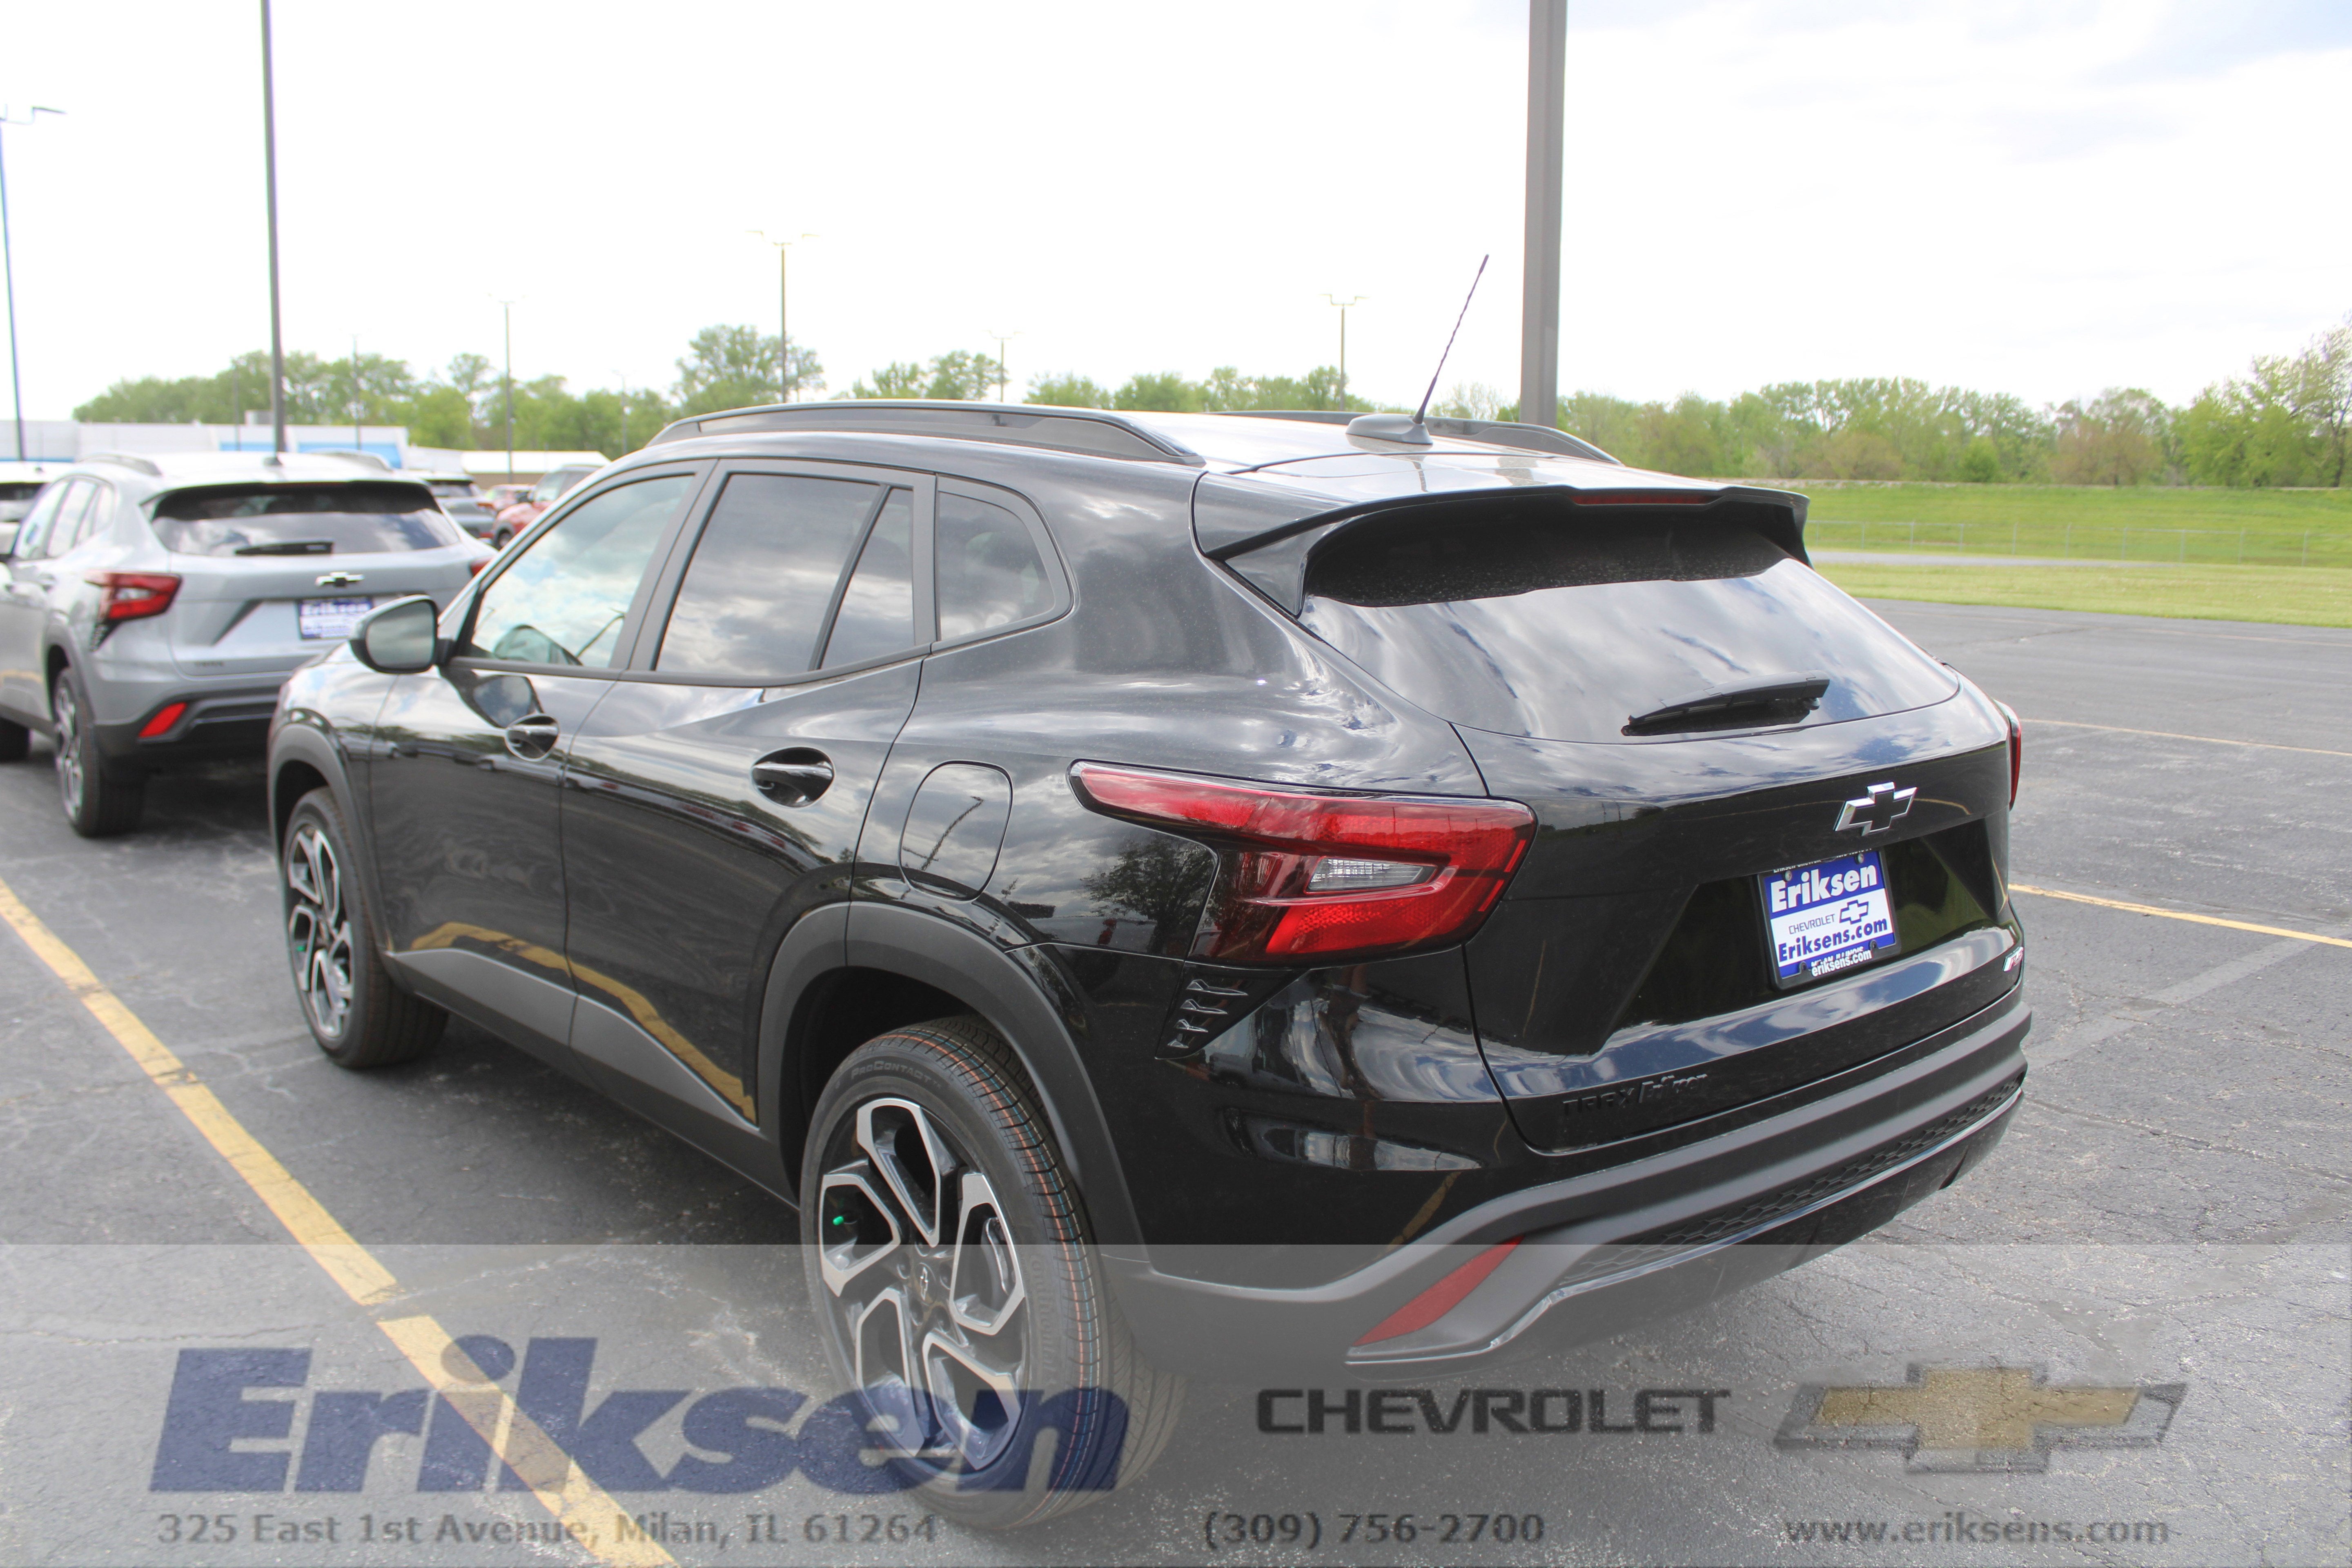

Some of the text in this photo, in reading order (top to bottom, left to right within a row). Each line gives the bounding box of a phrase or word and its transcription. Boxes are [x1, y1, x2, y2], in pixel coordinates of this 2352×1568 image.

[1771, 865, 1877, 913] Eriksen
[1778, 918, 1888, 962] Eriksens.com
[1788, 914, 1835, 935] CHEVROLET
[1811, 950, 1872, 977] eriksens.com
